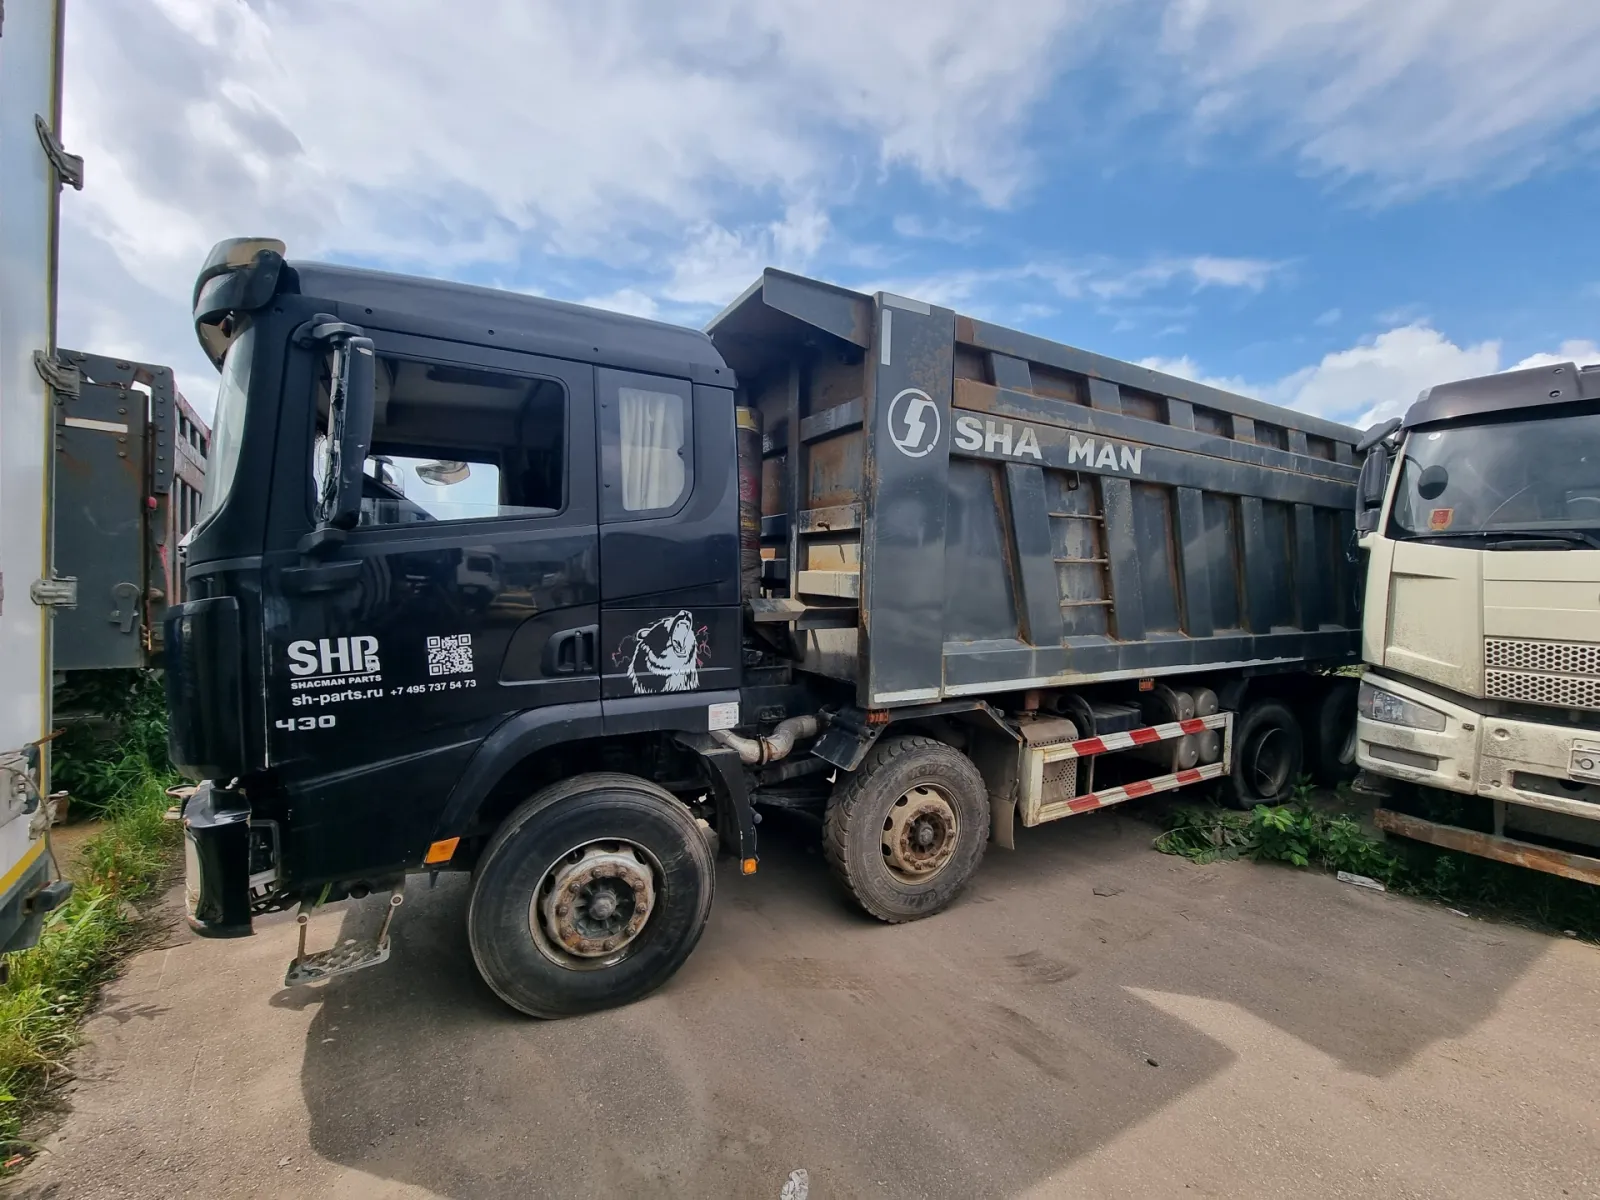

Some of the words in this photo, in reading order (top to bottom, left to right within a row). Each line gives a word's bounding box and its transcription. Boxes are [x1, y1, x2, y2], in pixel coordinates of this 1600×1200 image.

[954, 416, 1042, 460] SHA
[1067, 435, 1142, 475] MAN
[290, 677, 346, 690] SHACMAN
[348, 674, 382, 685] PARTS
[390, 686, 404, 696] +7
[406, 684, 426, 694] 495
[428, 682, 447, 692] 737
[449, 680, 462, 690] 54
[464, 679, 477, 688] 73
[291, 688, 384, 706] sh-parts.ru
[275, 714, 336, 732] 430
